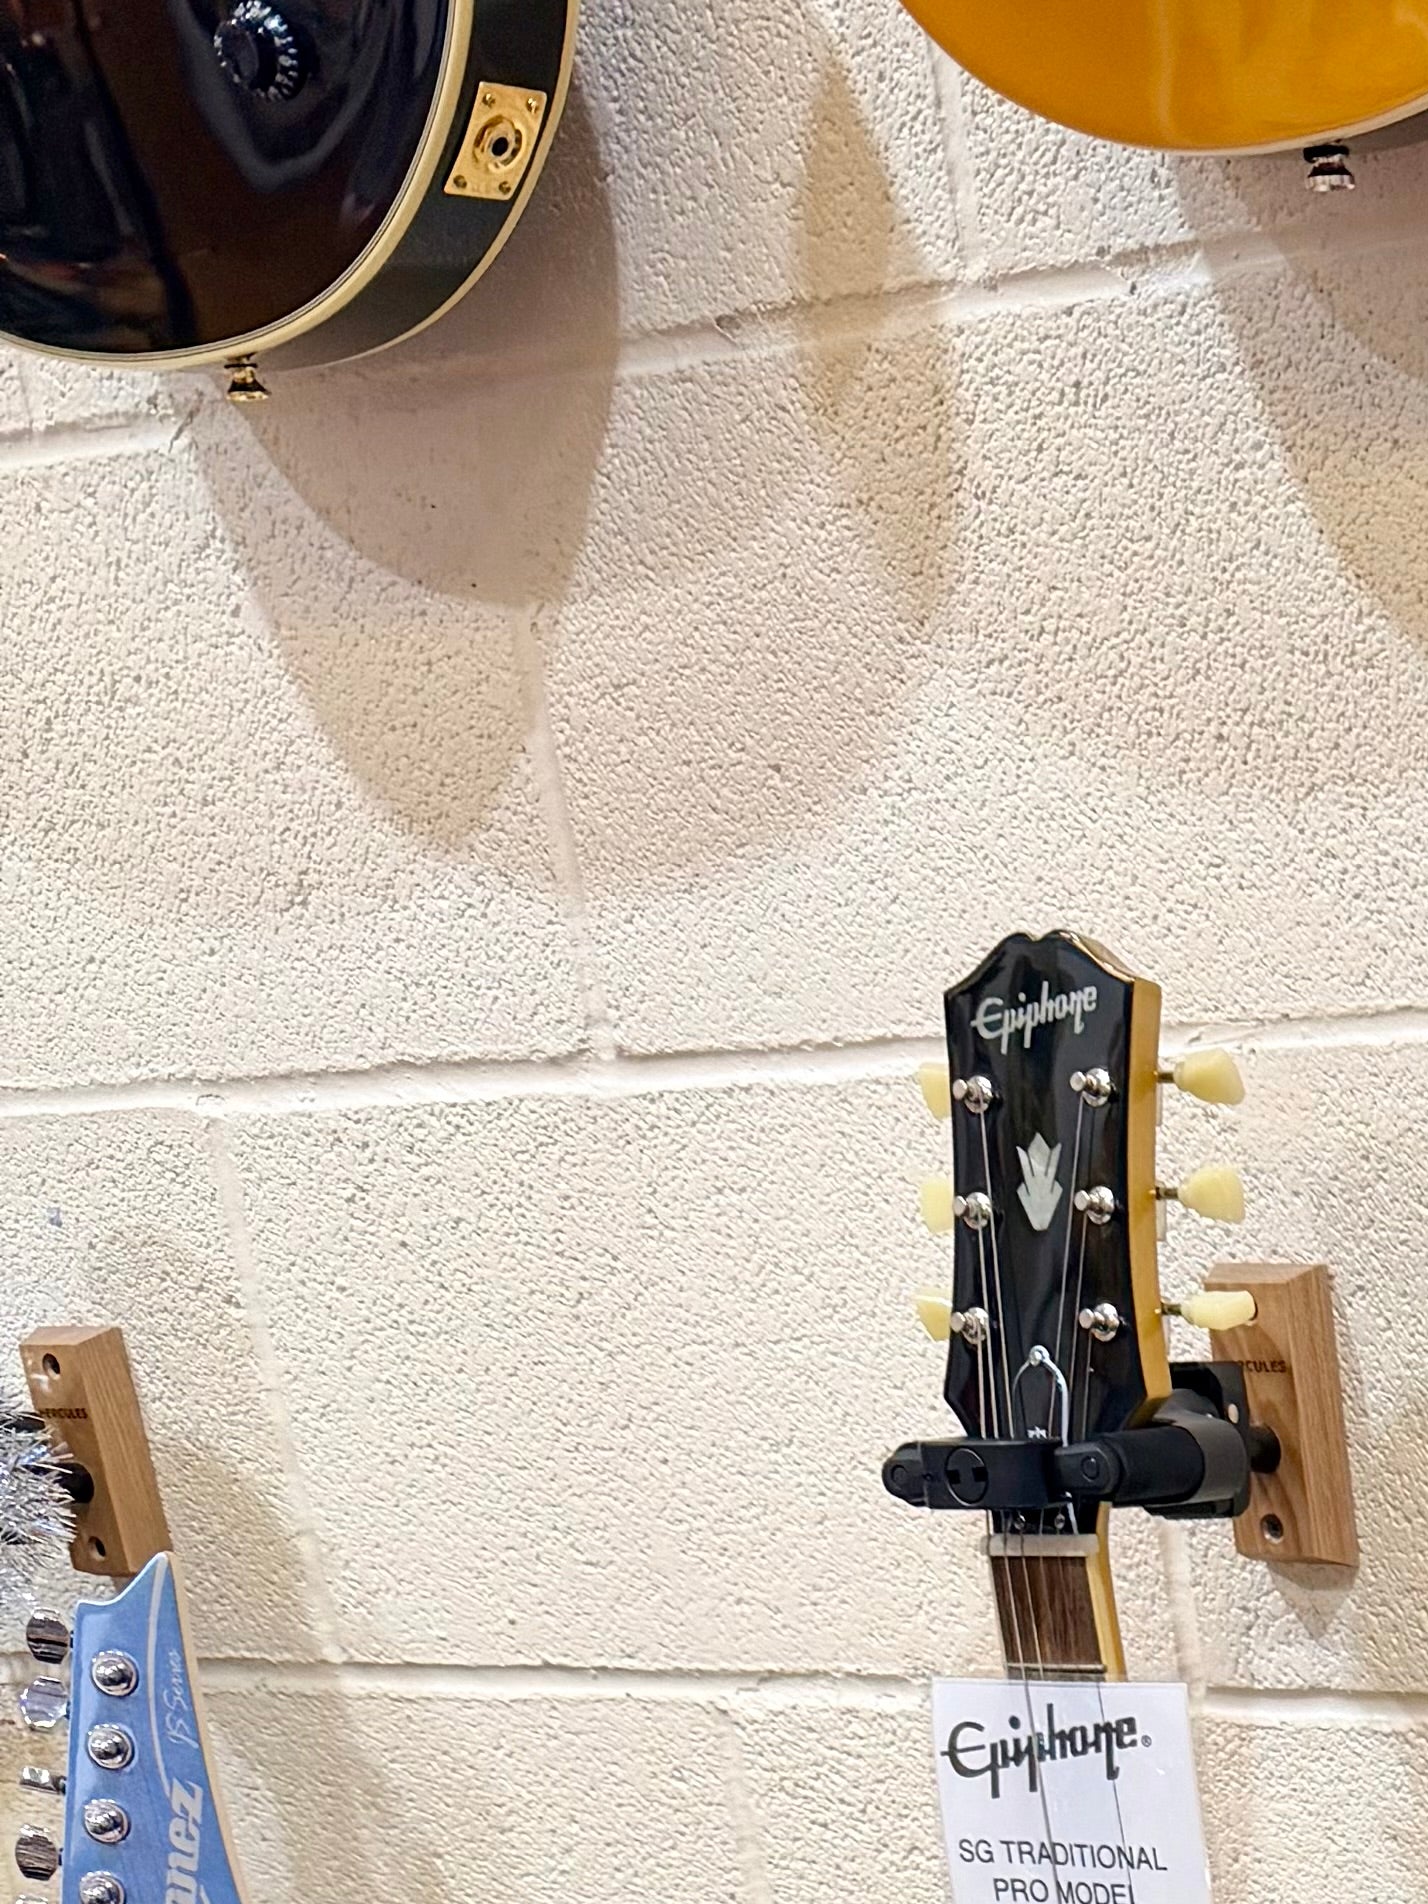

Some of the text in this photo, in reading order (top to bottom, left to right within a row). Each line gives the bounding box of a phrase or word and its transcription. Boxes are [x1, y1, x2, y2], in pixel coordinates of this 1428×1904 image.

[970, 980, 1097, 1055] Epiphone
[162, 1647, 189, 1711] Series
[940, 1703, 1138, 1799] Epiphone
[958, 1838, 1168, 1871] SG TRADITIONAL
[993, 1878, 1049, 1902] PRO
